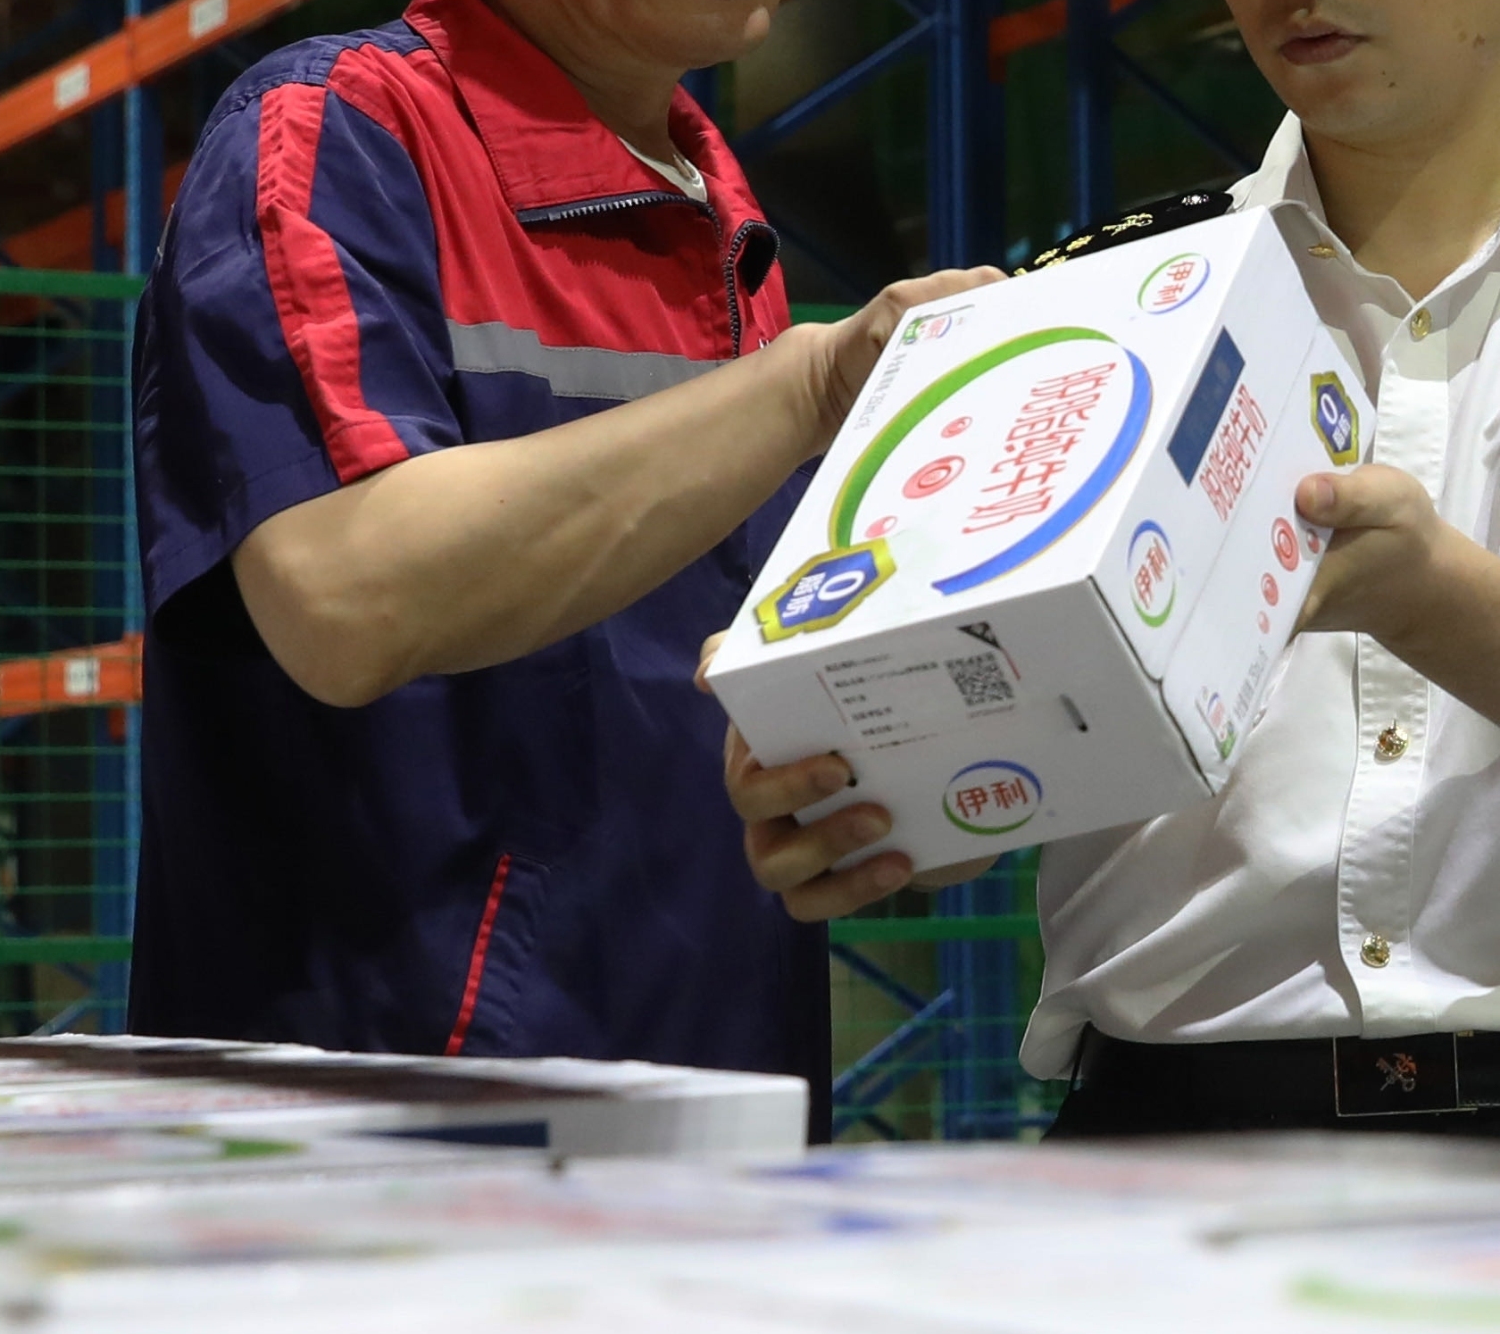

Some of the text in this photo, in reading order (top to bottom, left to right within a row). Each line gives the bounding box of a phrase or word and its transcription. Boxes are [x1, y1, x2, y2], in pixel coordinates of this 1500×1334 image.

[1153, 261, 1195, 306] 伊利
[1320, 393, 1338, 425] 0
[961, 362, 1117, 535] 脱脂纯牛奶
[1199, 383, 1268, 522] 脱脂纯牛奶
[817, 570, 865, 601] 0
[1134, 536, 1169, 610] 伊利
[955, 776, 1029, 820] 伊利
